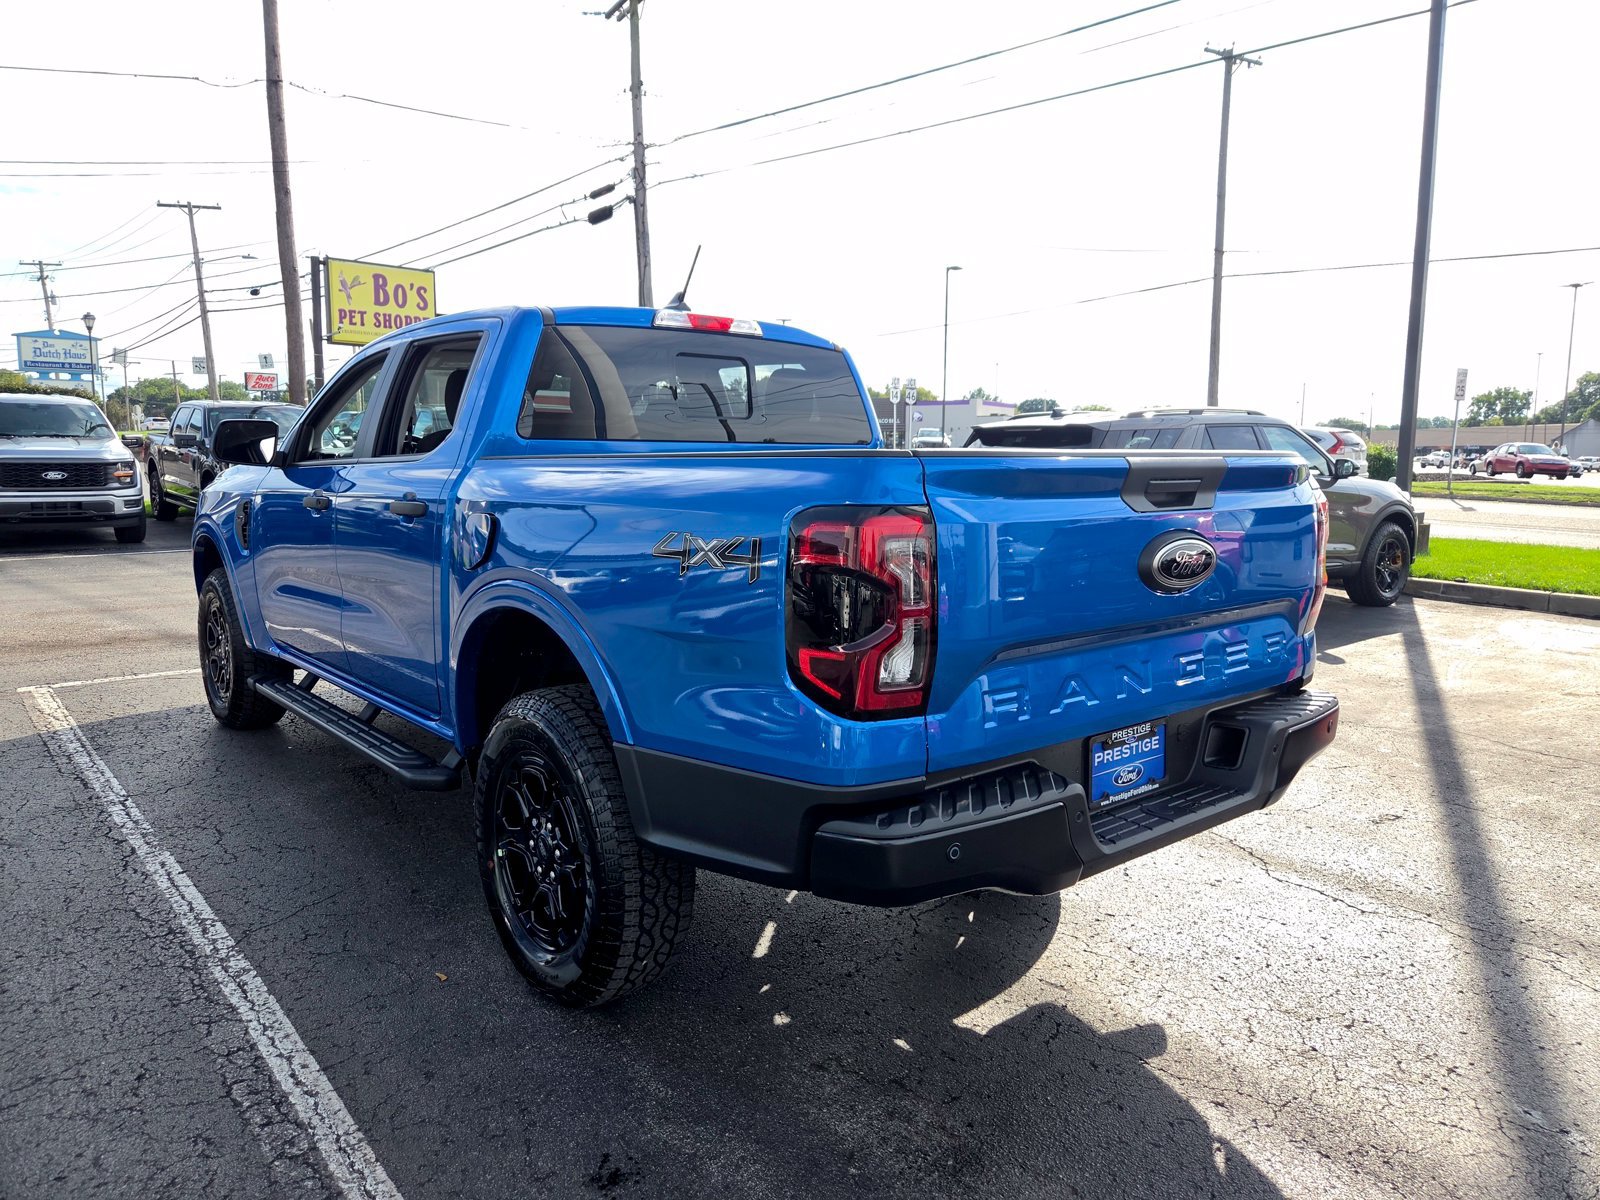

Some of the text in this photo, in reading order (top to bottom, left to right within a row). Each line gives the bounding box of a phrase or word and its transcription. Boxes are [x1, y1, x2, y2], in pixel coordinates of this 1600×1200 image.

[338, 308, 367, 327] PET
[32, 347, 87, 360] Dutch Haus
[255, 374, 276, 382] Auto
[251, 381, 273, 389] Zone
[1456, 385, 1466, 397] 25
[906, 391, 916, 401] 46
[983, 631, 1289, 728] RANGER
[1112, 723, 1151, 740] PRESTIGE
[1095, 736, 1160, 766] PRESTIGE
